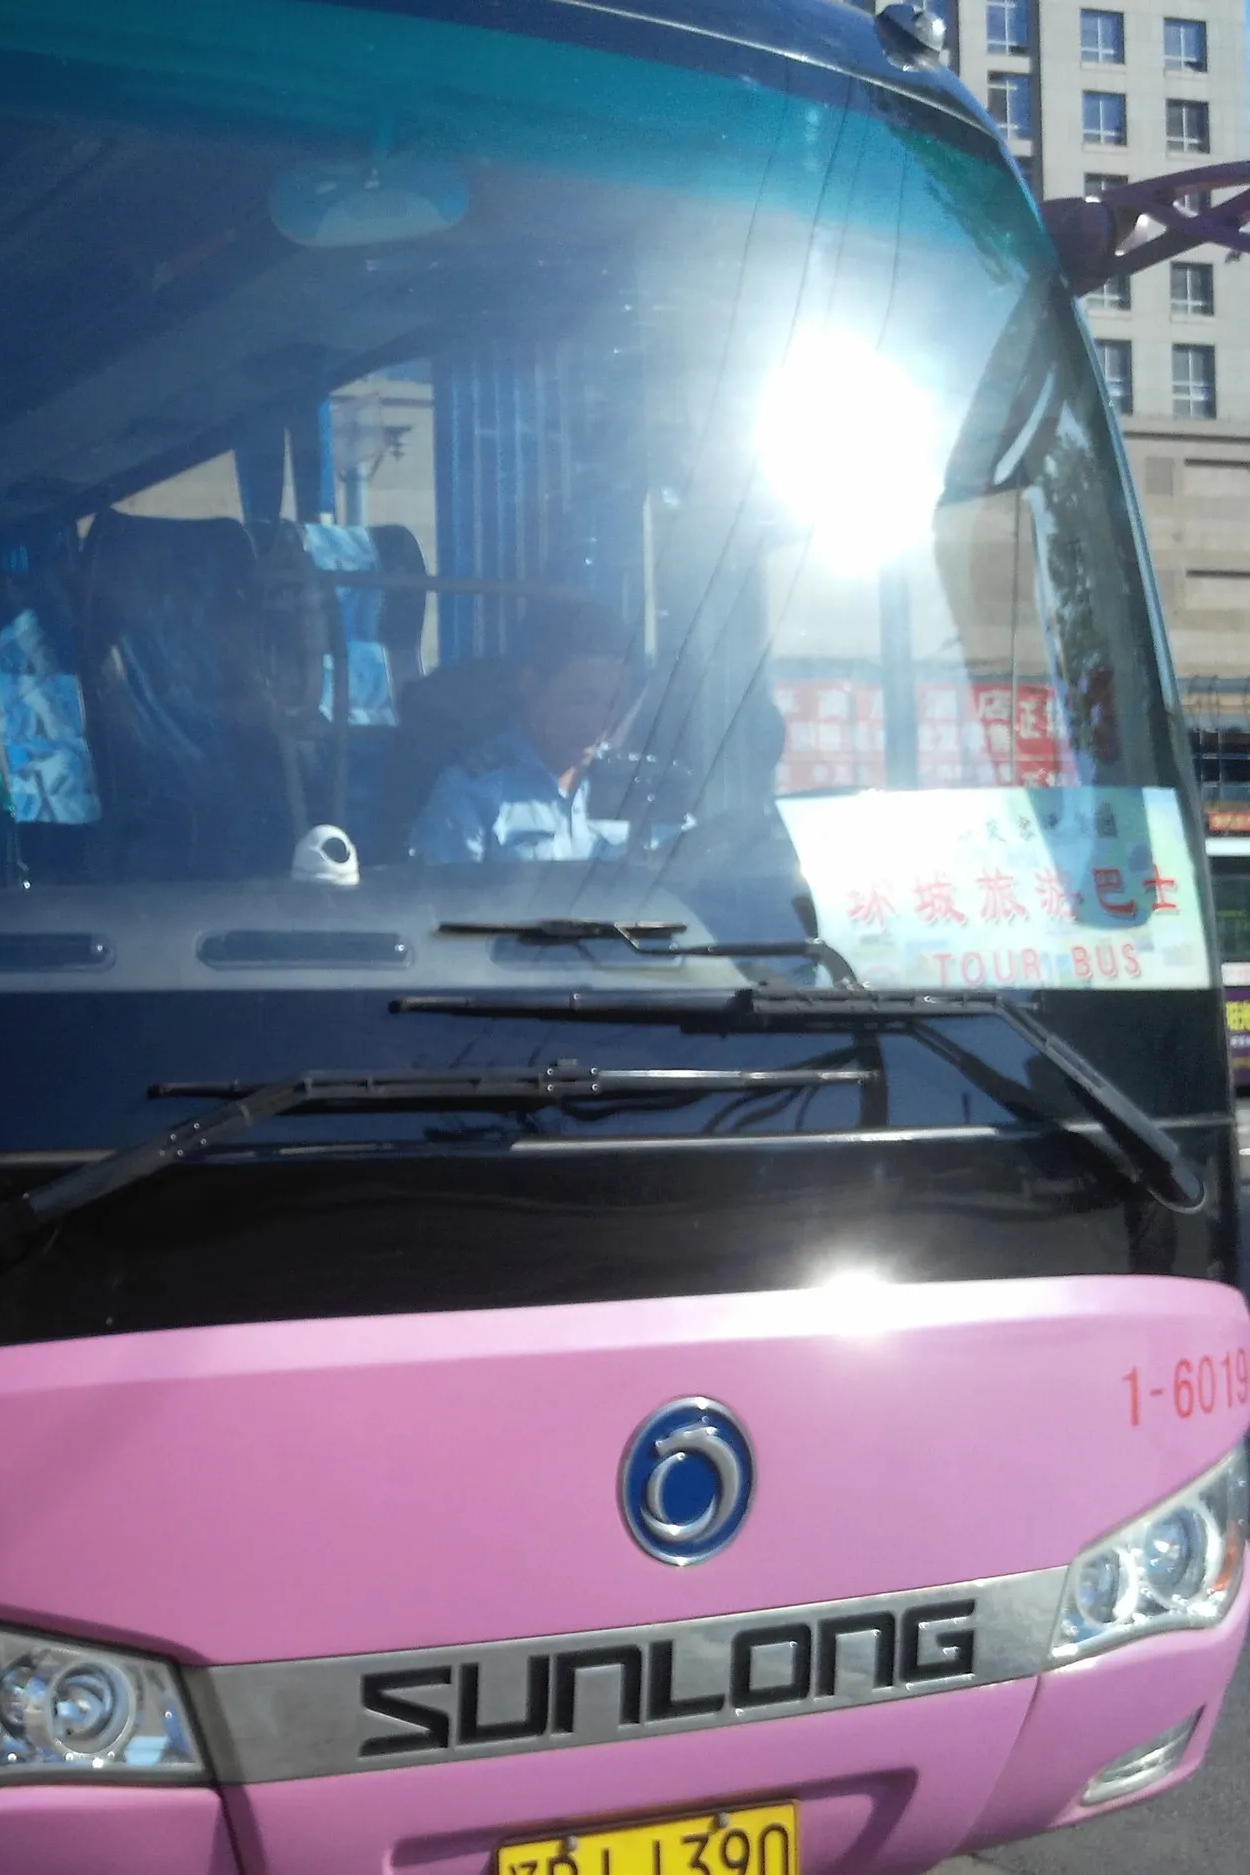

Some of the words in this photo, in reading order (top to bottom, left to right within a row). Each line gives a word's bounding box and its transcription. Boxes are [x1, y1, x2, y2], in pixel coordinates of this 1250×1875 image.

[932, 947, 1043, 987] TOUR
[1070, 943, 1142, 979] BUS
[1121, 1346, 1250, 1428] 1-6019
[358, 1599, 976, 1758] SUNLONG
